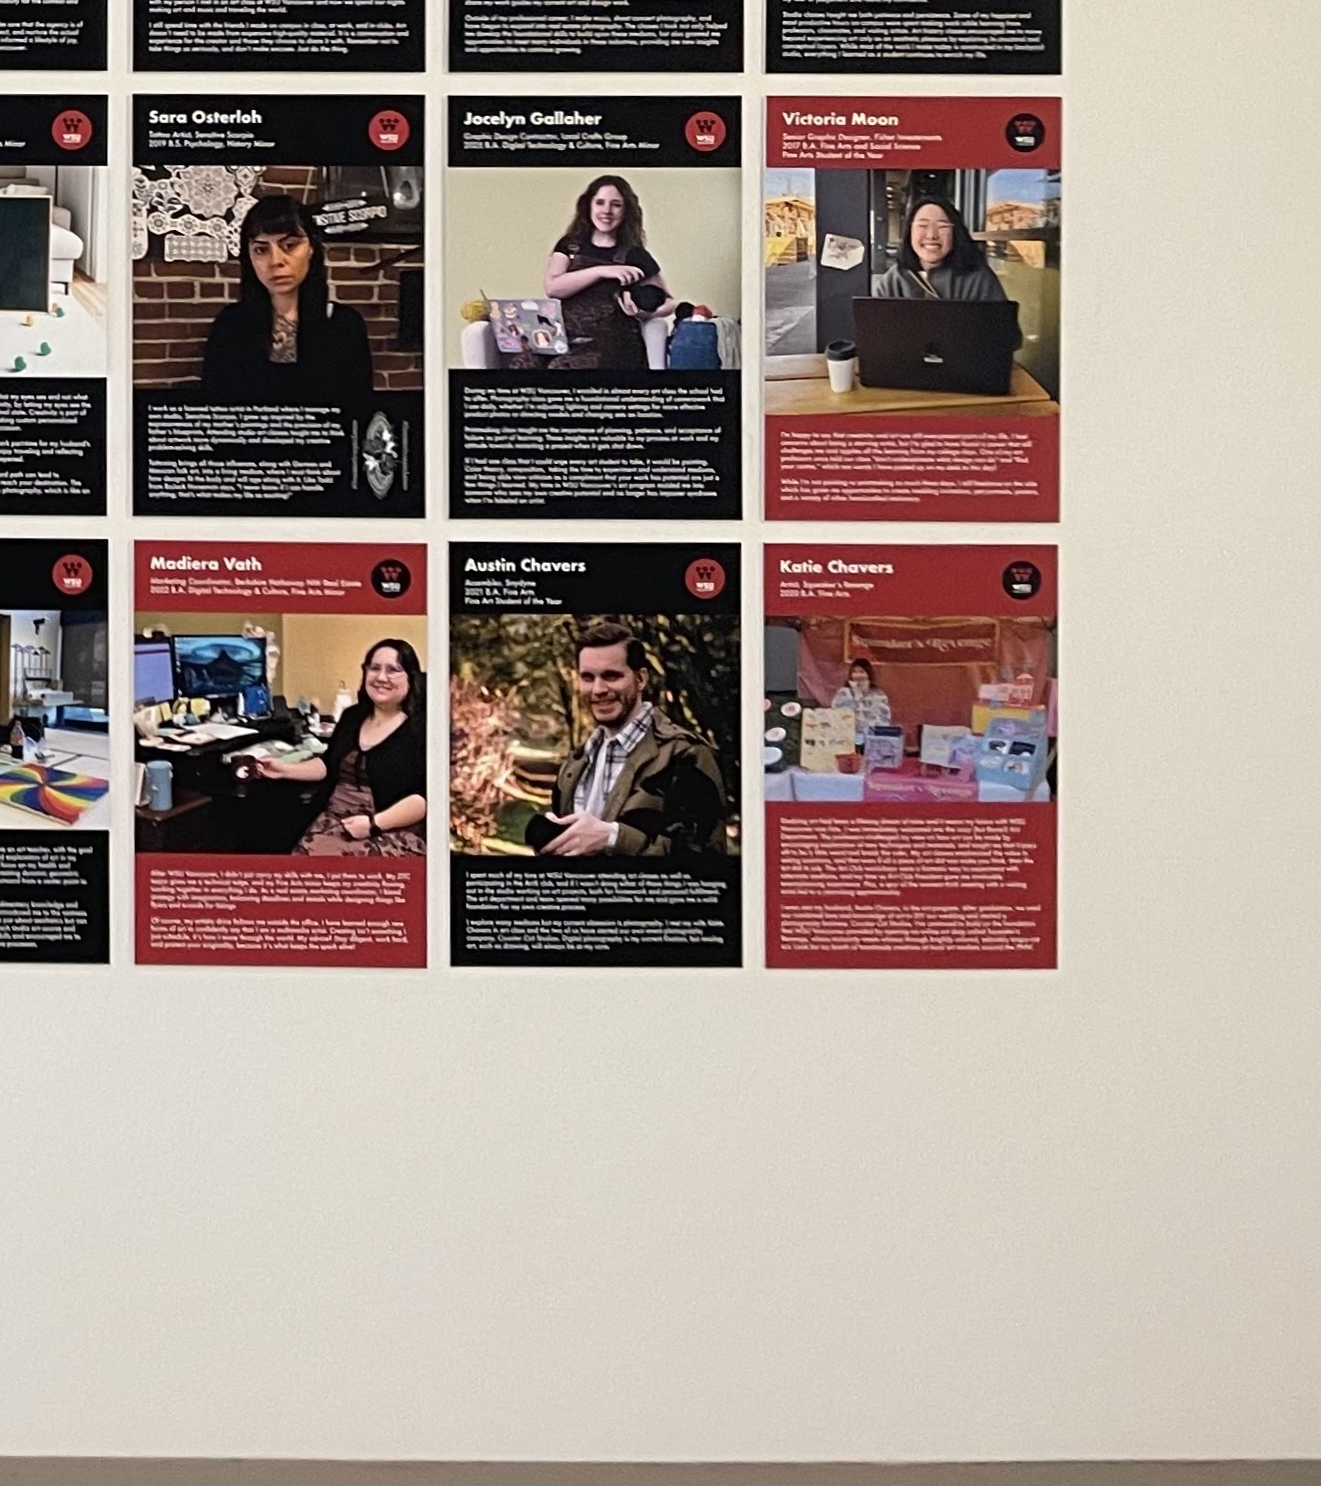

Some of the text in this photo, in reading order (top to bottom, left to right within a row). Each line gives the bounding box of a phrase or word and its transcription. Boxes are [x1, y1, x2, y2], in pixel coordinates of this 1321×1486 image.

[149, 110, 262, 123] Sara Osterloh
[464, 111, 602, 128] Jocelyn Gallaher
[782, 112, 898, 125] Victoria Moon
[151, 556, 262, 570] Madiera Vath
[465, 558, 586, 572] Austin Chavers
[780, 560, 893, 573] Katie Chavers
